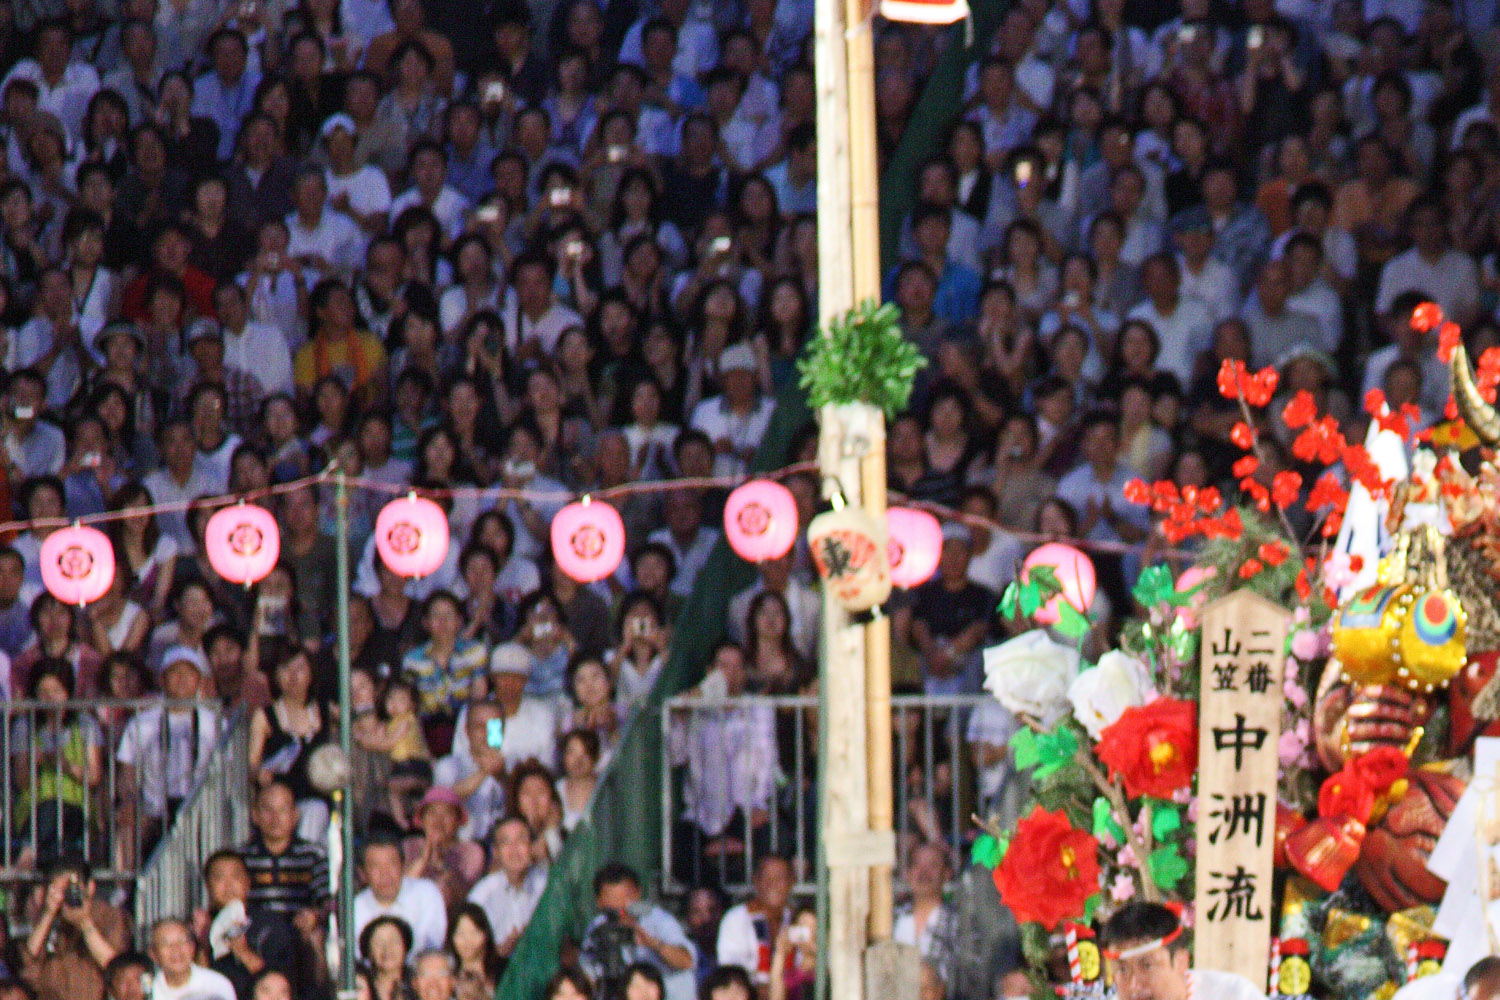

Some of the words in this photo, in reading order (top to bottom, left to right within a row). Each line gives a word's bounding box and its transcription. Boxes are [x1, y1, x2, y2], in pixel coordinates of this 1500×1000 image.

[1211, 628, 1241, 692] 山笠
[1244, 629, 1275, 694] 二番
[1206, 713, 1269, 923] 中洲流
